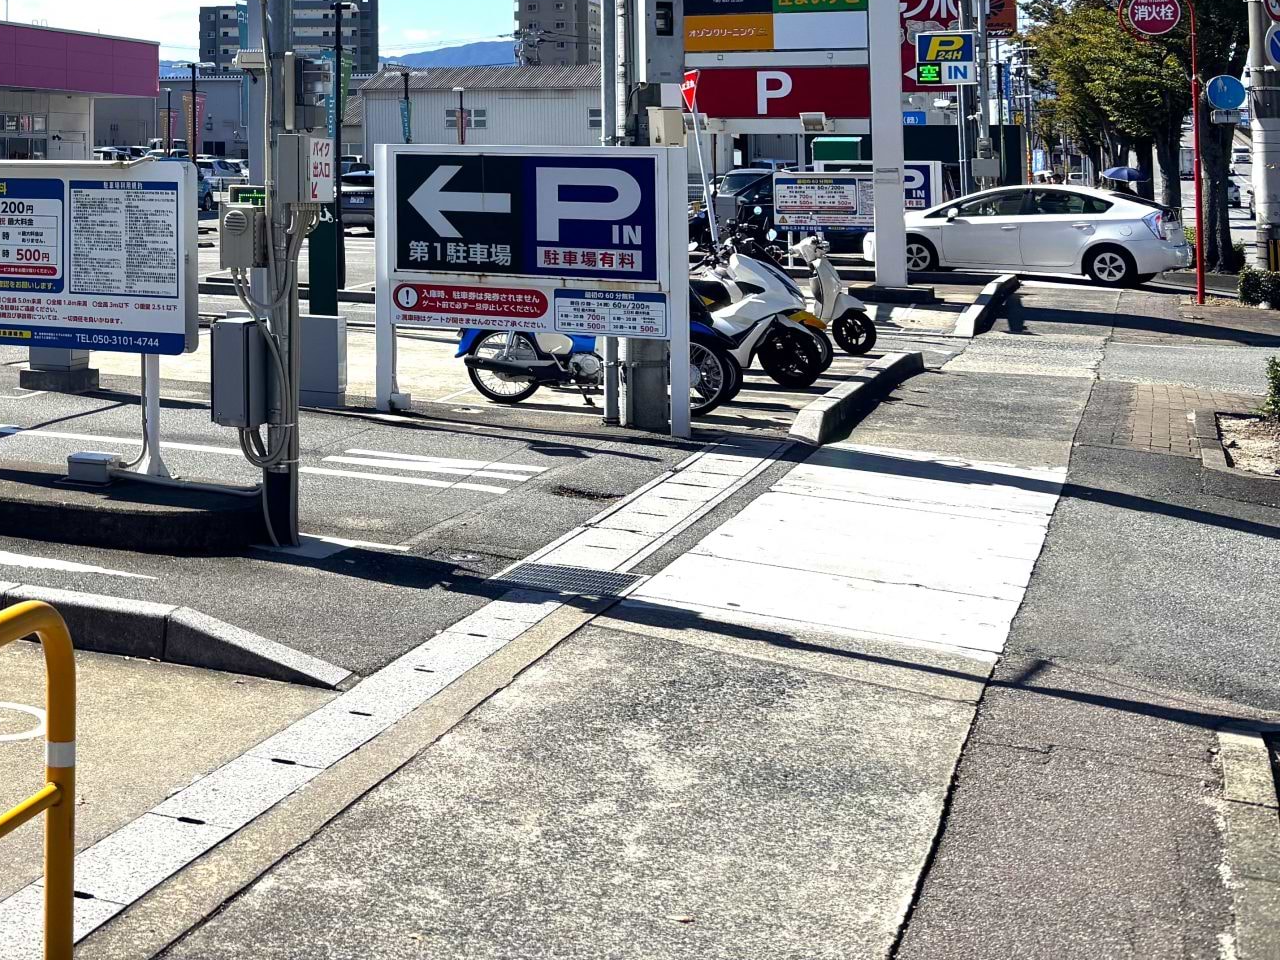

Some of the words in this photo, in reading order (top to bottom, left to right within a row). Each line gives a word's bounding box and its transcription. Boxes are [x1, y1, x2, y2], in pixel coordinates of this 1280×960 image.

[1134, 4, 1175, 21] 消火栓
[688, 27, 756, 37] オゾンクリーニング
[926, 36, 964, 60] P
[937, 50, 962, 60] 24H
[948, 65, 968, 80] IN
[756, 71, 793, 115] P
[312, 142, 330, 157] バイク
[312, 162, 330, 178] 出入口
[536, 166, 642, 241] P
[612, 225, 642, 245] IN
[16, 249, 50, 262] 500円
[408, 241, 512, 266] 第1駐車場
[544, 249, 635, 270] 駐車場有料
[75, 333, 160, 347] TEL.050-3101-4744
